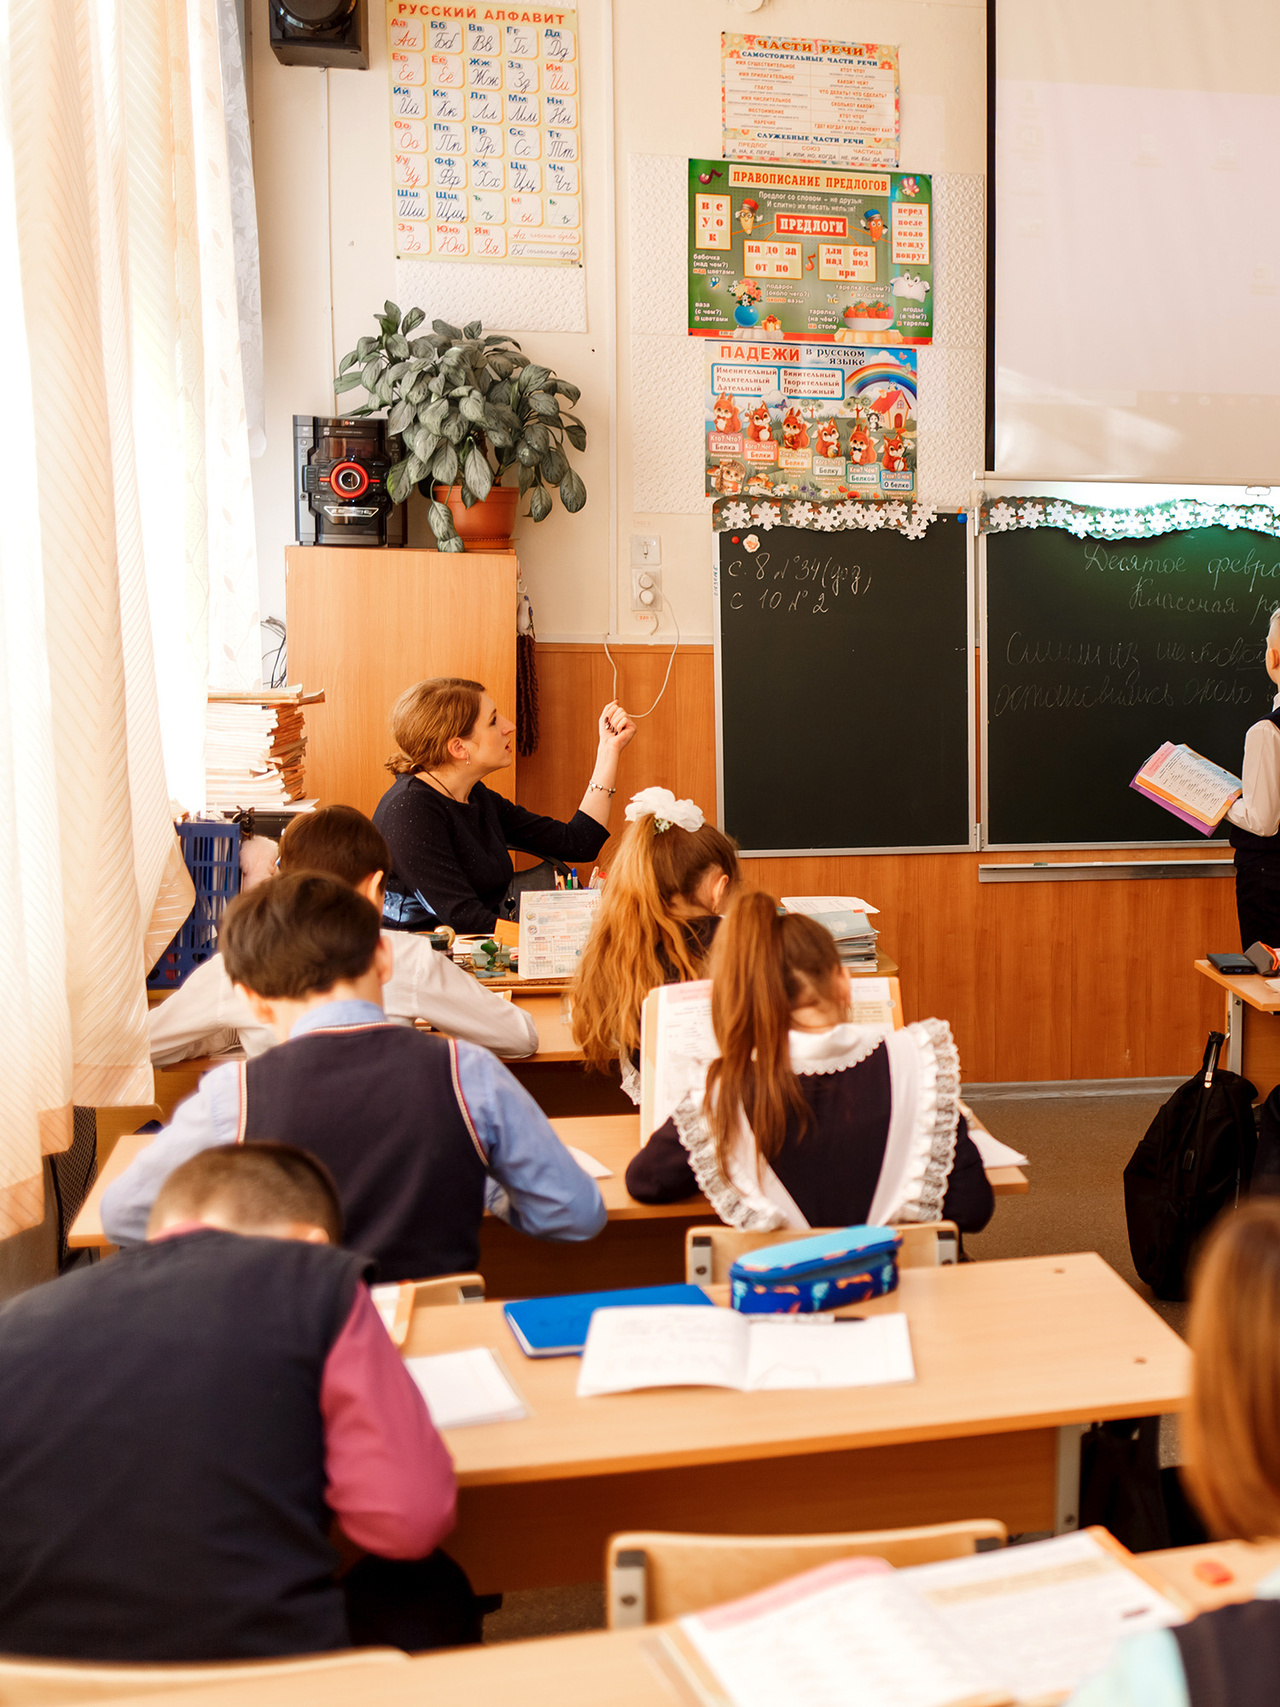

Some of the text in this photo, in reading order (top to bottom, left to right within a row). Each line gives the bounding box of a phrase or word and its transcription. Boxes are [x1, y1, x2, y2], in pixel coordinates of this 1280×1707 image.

[398, 3, 565, 25] РУССКИЙ АЛФАВИТ
[391, 18, 560, 37] Аа Бб Вв Дд
[757, 40, 864, 57] ЧАСТИ РЕЧИ
[392, 53, 561, 71] Ее Жж Зз Ии
[742, 51, 823, 62] САМОСТОЯТЕЛЬНЫЕ
[827, 57, 854, 65] ЧАСТИ
[432, 89, 562, 105] Кк Лл Мм Нн
[394, 120, 560, 138] Оо Пп Рр Сс Тт
[757, 132, 809, 141] СЛУЖЕБНЫЕ
[395, 154, 409, 165] Уу
[434, 157, 455, 167] Фф
[472, 159, 487, 167] Хх
[510, 162, 526, 170] Цц
[733, 171, 888, 191] ПРАВОПИСАНИЕ ПРЕДЛОГОВ
[397, 189, 458, 200] Шш Щщ
[758, 191, 786, 201] Предлог
[701, 202, 710, 210] в
[702, 217, 724, 228] у о
[780, 218, 844, 233] ПРЕДЛОГИ
[398, 223, 489, 235] Ээ Юю Яя
[709, 233, 716, 241] к
[747, 245, 797, 256] на до за
[896, 241, 925, 250] между
[693, 253, 720, 261] бабочка
[852, 248, 868, 257] без
[895, 252, 926, 261] вокруг
[755, 263, 789, 273] от по
[825, 258, 869, 267] над под
[838, 270, 856, 279] при
[720, 345, 800, 362] ПАДЕЖИ
[817, 349, 865, 358] русском
[829, 358, 865, 366] языке
[716, 367, 777, 376] Именительный
[783, 370, 836, 378] Винительный
[717, 376, 771, 384] Родительный
[783, 378, 840, 387] Творительный
[716, 384, 762, 392] Дательный
[783, 387, 835, 395] Предложный
[1084, 543, 1187, 573] Десятое
[755, 552, 771, 580] 8
[758, 588, 783, 610] 10
[1129, 576, 1239, 613] Классная
